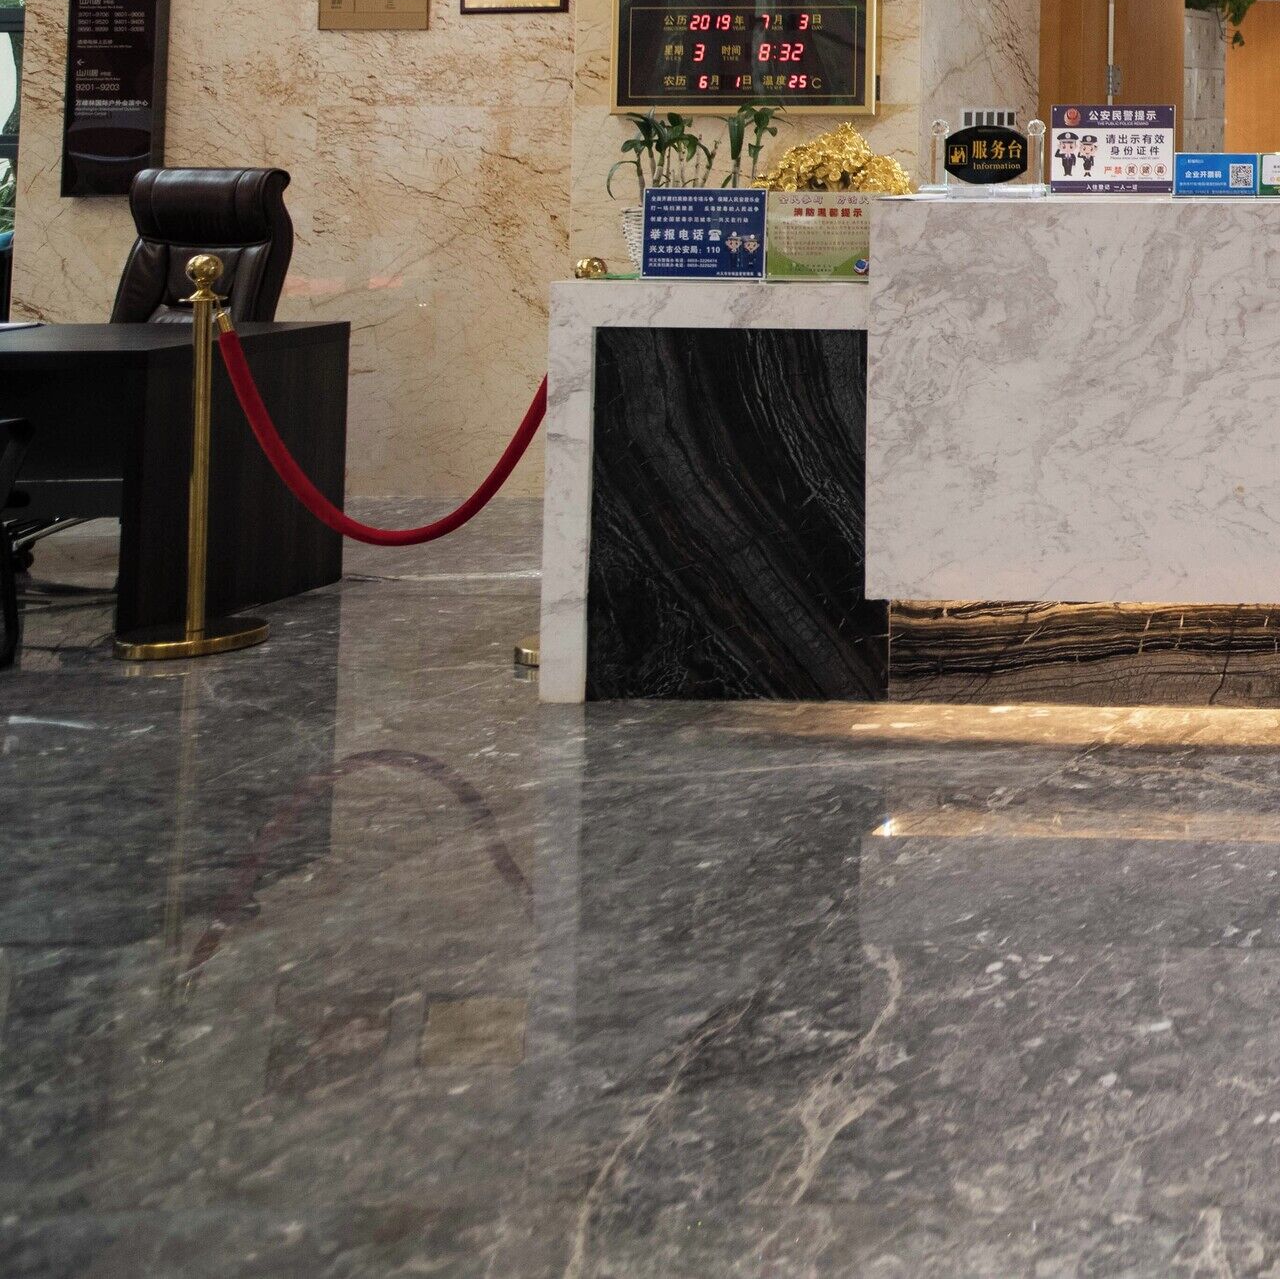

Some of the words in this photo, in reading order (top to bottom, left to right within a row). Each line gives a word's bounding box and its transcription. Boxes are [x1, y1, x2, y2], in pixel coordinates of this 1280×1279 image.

[664, 15, 687, 25] 公历
[689, 14, 731, 31] 2019
[734, 15, 745, 25] 年
[761, 14, 770, 30] 7
[773, 15, 783, 24] 月
[799, 14, 809, 30] 3
[812, 14, 822, 24] 日
[664, 44, 684, 55] 星期
[693, 43, 705, 61] 3
[721, 44, 741, 56] 时间
[758, 43, 804, 62] 8:32
[663, 75, 686, 86] 农历
[698, 75, 708, 89] 6
[711, 75, 719, 85] 月
[735, 76, 740, 88] 1
[743, 75, 752, 85] 日
[763, 75, 786, 85] 温度
[788, 75, 807, 88] 25
[1089, 110, 1157, 121] 公安民警提示
[1106, 134, 1165, 144] 请出示有效
[972, 140, 1022, 159] 服务台
[1110, 146, 1160, 156] 身份证件
[973, 162, 1021, 170] Information
[1104, 166, 1122, 174] 严禁
[1184, 170, 1222, 179] 企业开票码
[794, 207, 863, 218] 消防温馨提示
[650, 228, 704, 241] 举报电话
[706, 246, 721, 254] 110
